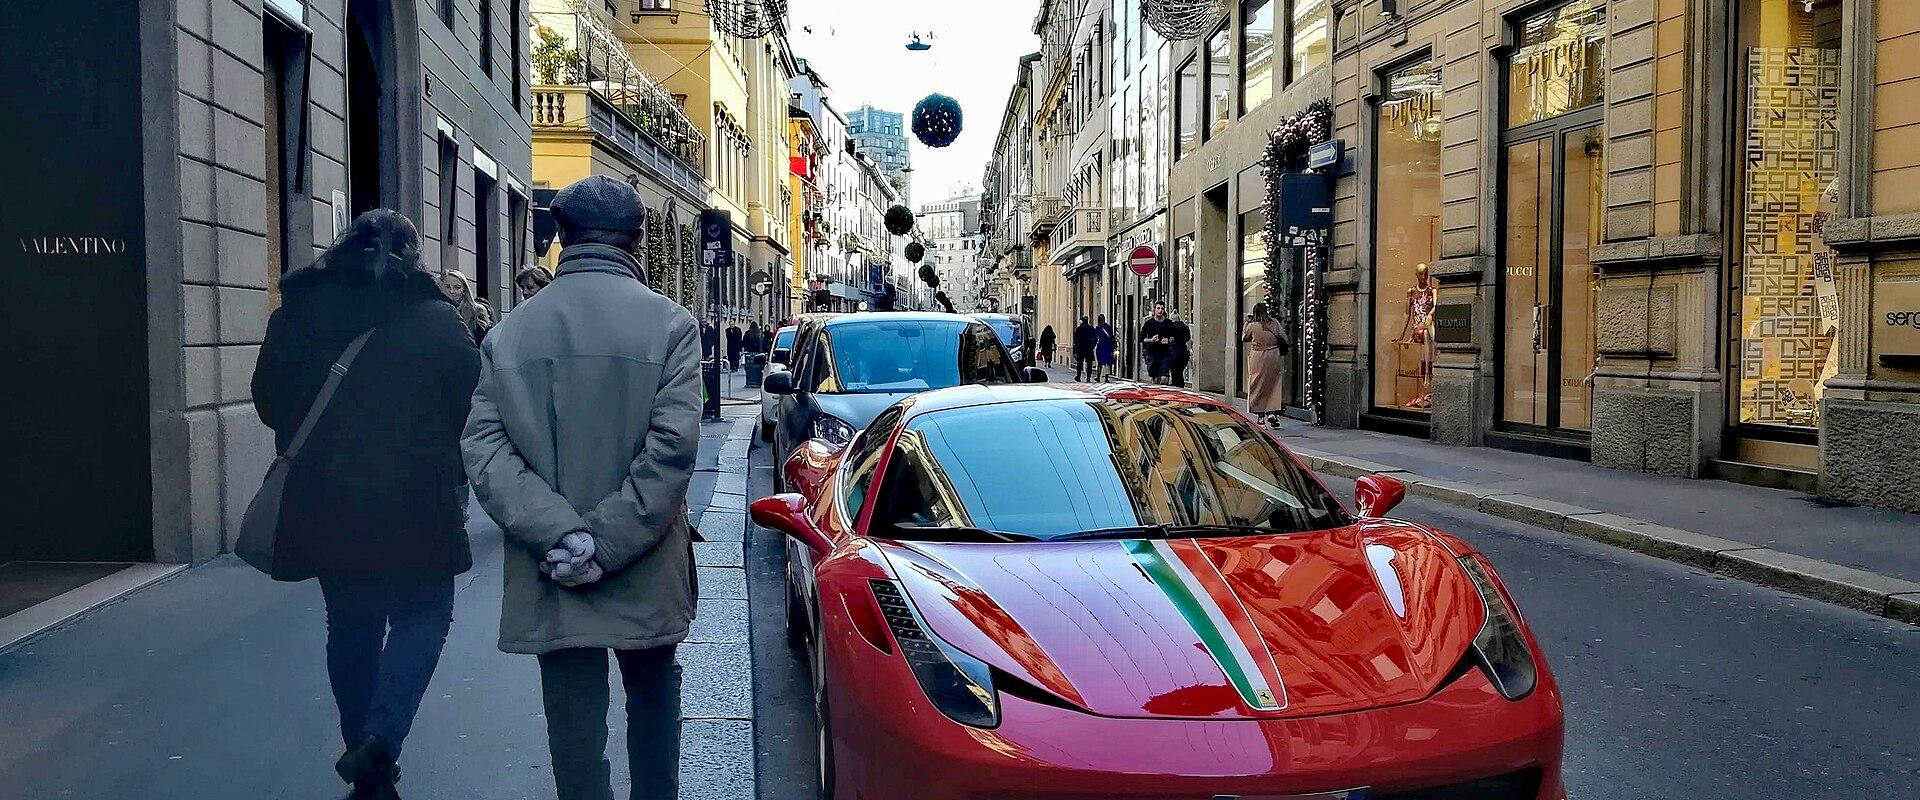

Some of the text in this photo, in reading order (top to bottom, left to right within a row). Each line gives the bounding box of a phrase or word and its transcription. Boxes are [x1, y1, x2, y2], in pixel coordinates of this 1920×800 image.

[1524, 37, 1588, 88] PUCCI
[1387, 90, 1434, 132] PUCCI
[19, 236, 126, 254] VALENTINO
[1886, 311, 1920, 329] serg
